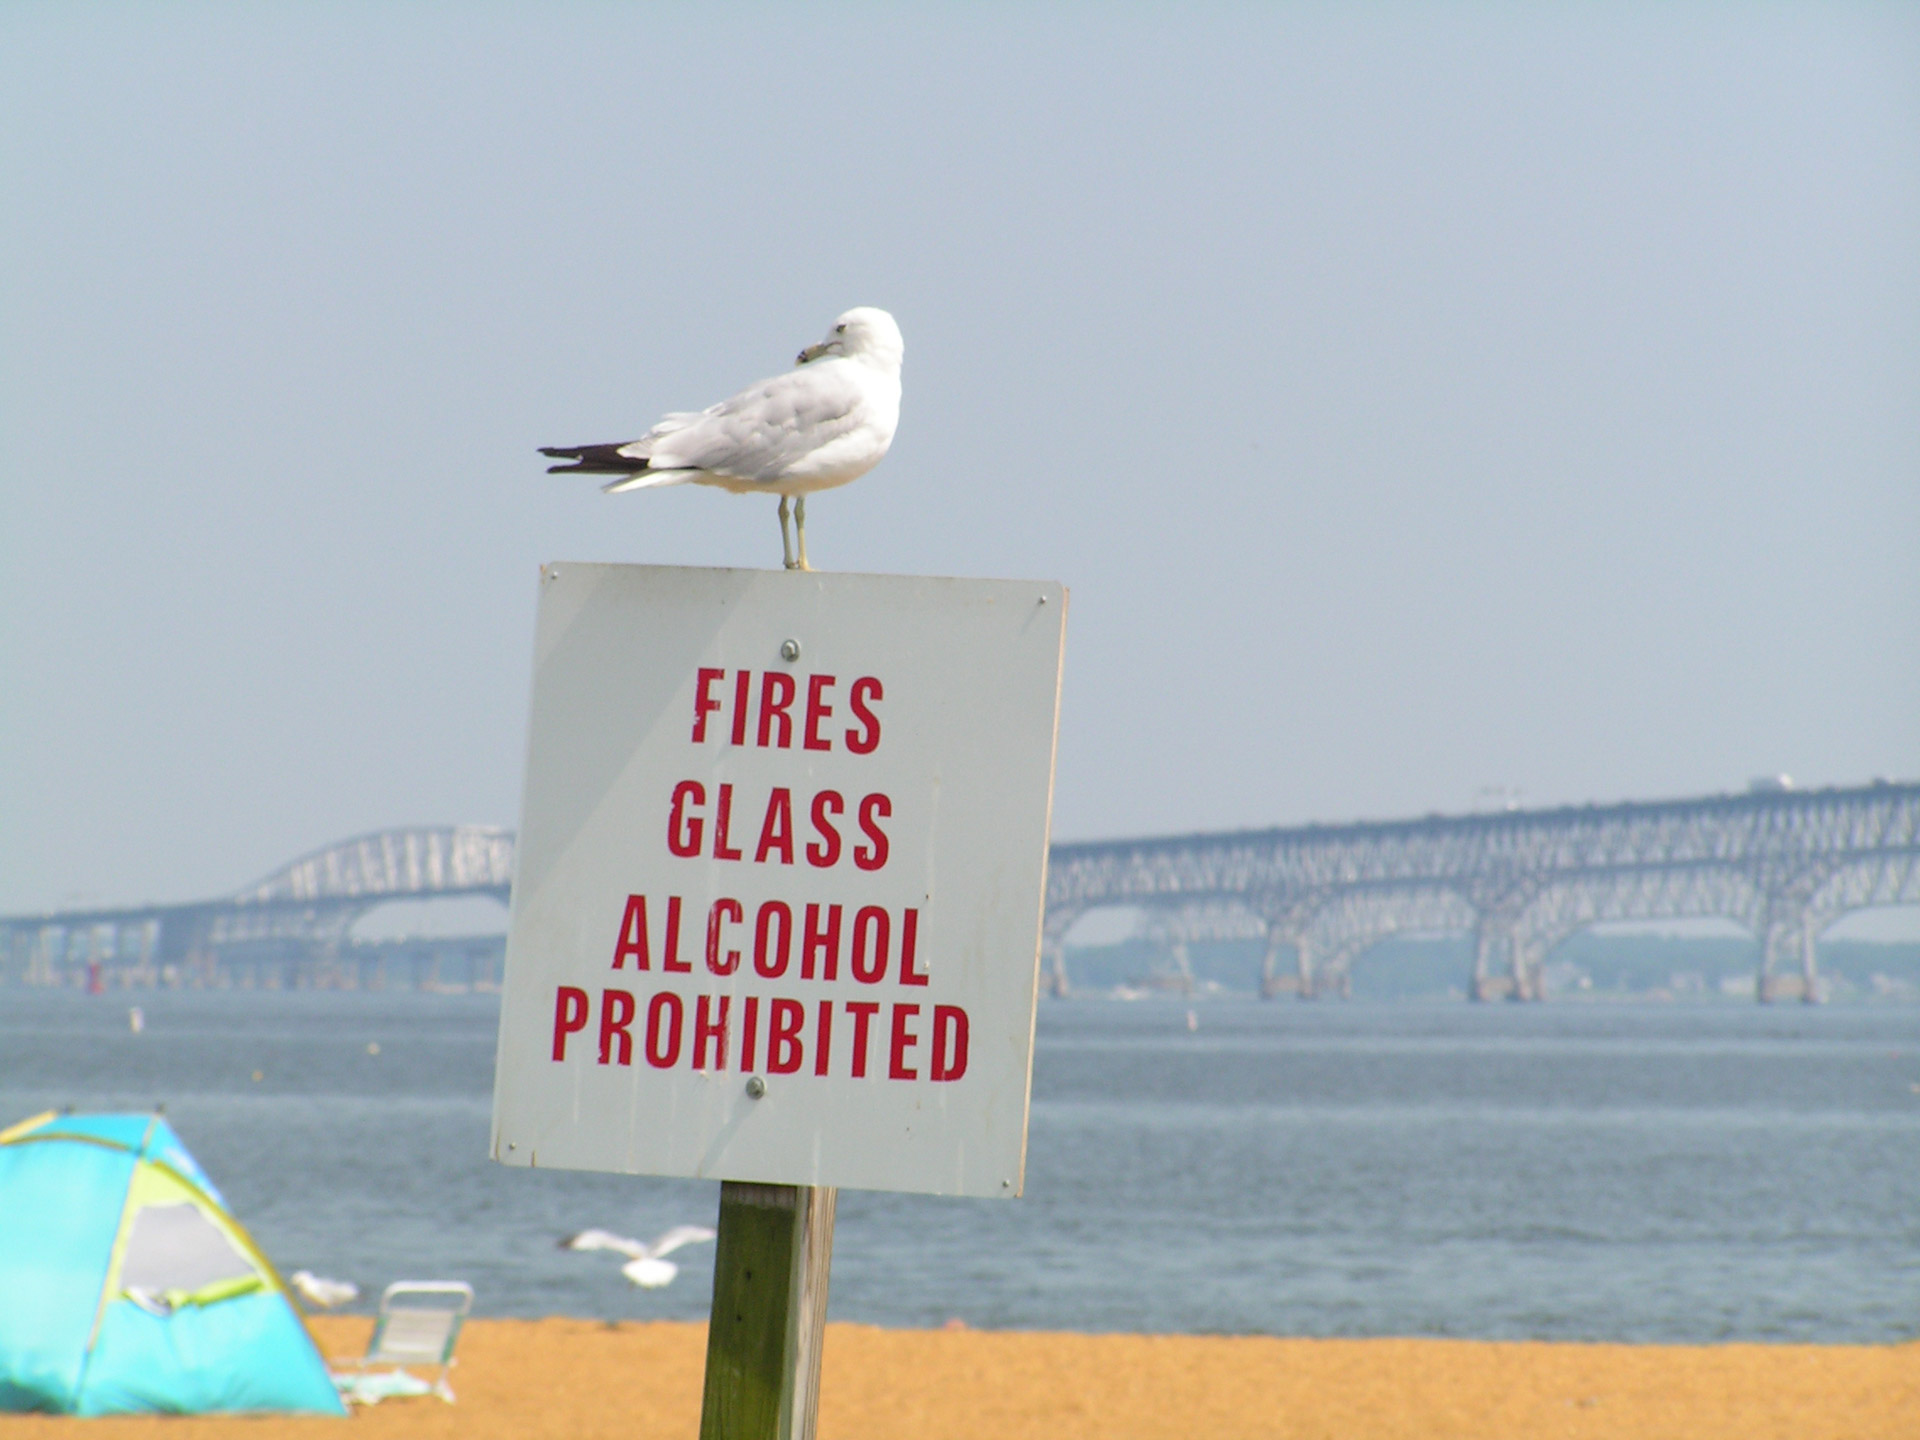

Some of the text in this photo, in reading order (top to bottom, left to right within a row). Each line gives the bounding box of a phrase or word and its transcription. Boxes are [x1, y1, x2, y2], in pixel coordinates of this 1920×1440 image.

[692, 667, 884, 755] FIRES
[667, 780, 892, 872] GLASS
[612, 894, 929, 987] ALCOHOL
[552, 986, 969, 1082] PROHIBITED
